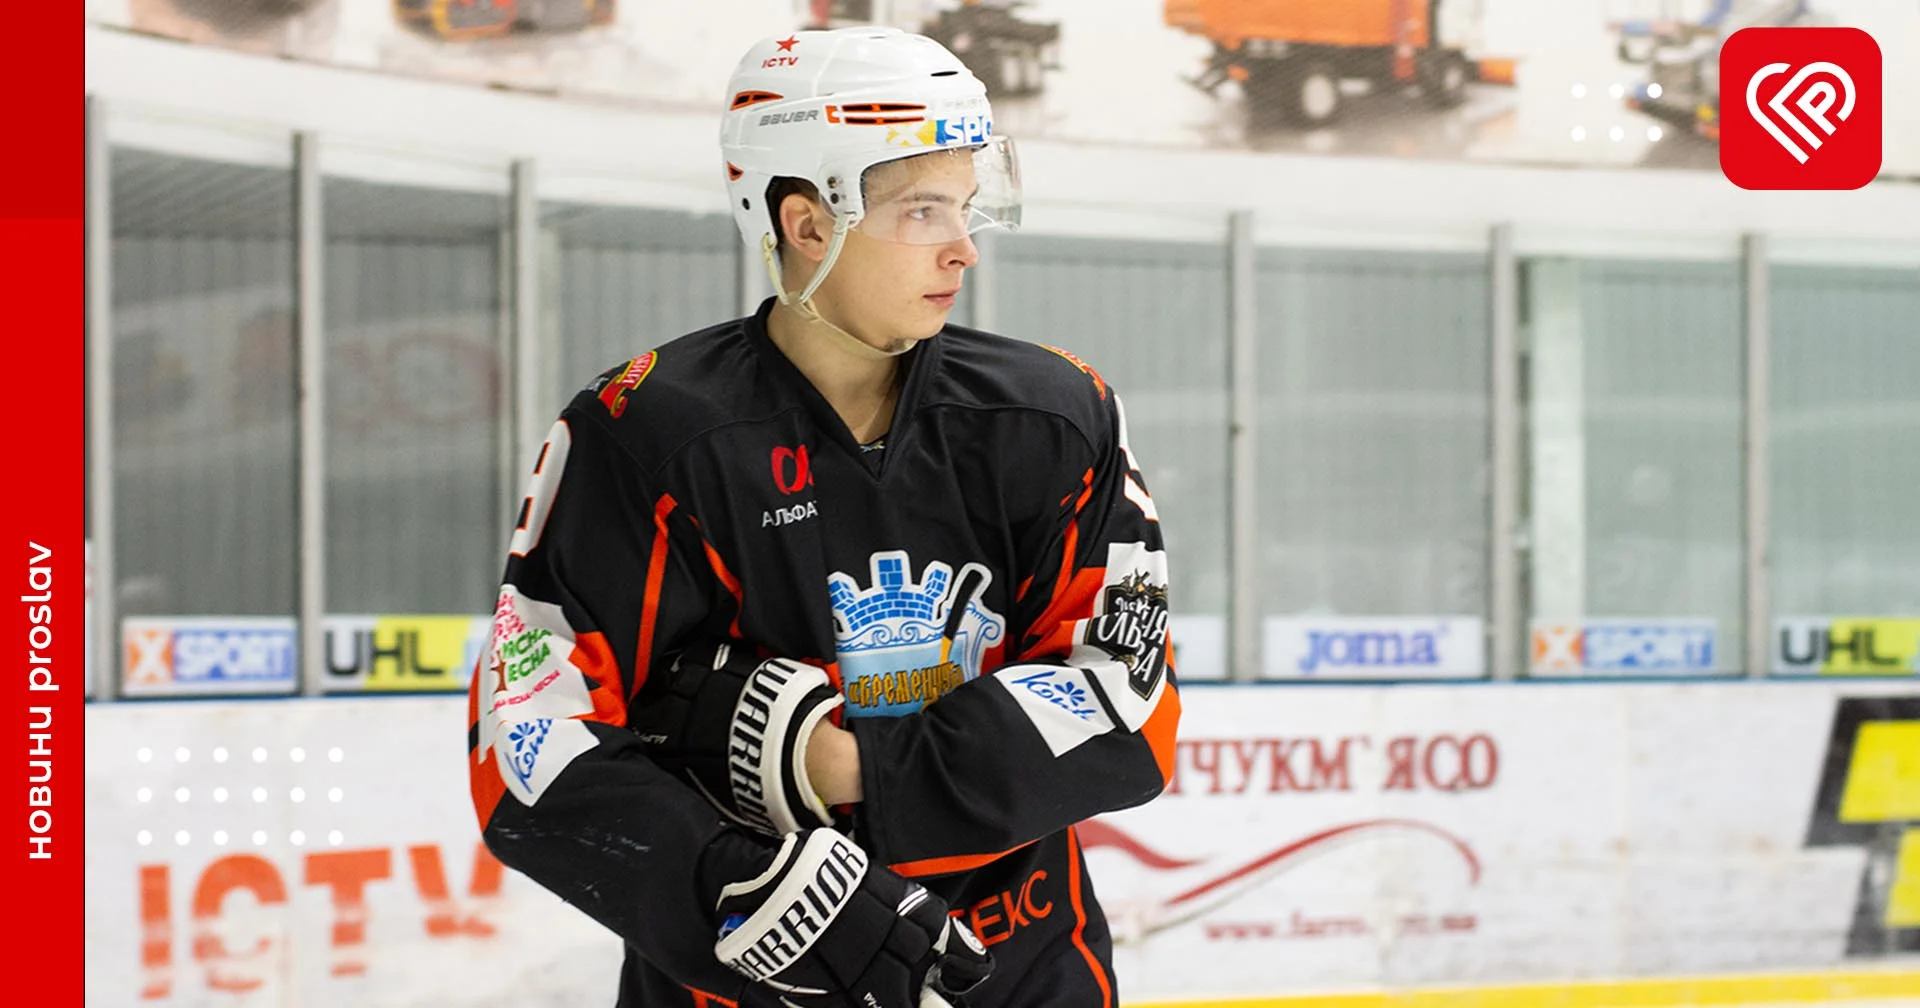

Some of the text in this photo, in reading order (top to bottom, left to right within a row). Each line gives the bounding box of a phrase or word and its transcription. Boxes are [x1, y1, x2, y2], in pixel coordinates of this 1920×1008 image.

[761, 56, 799, 69] ICTV
[758, 109, 819, 127] BAUER
[761, 501, 819, 528] АЛЬФА
[176, 630, 292, 681] SPORT
[324, 630, 446, 677] UHL
[1299, 630, 1441, 673] joma
[1780, 627, 1903, 666] UHL
[139, 842, 504, 998] ICTV
[947, 869, 1053, 948] ЕКС
